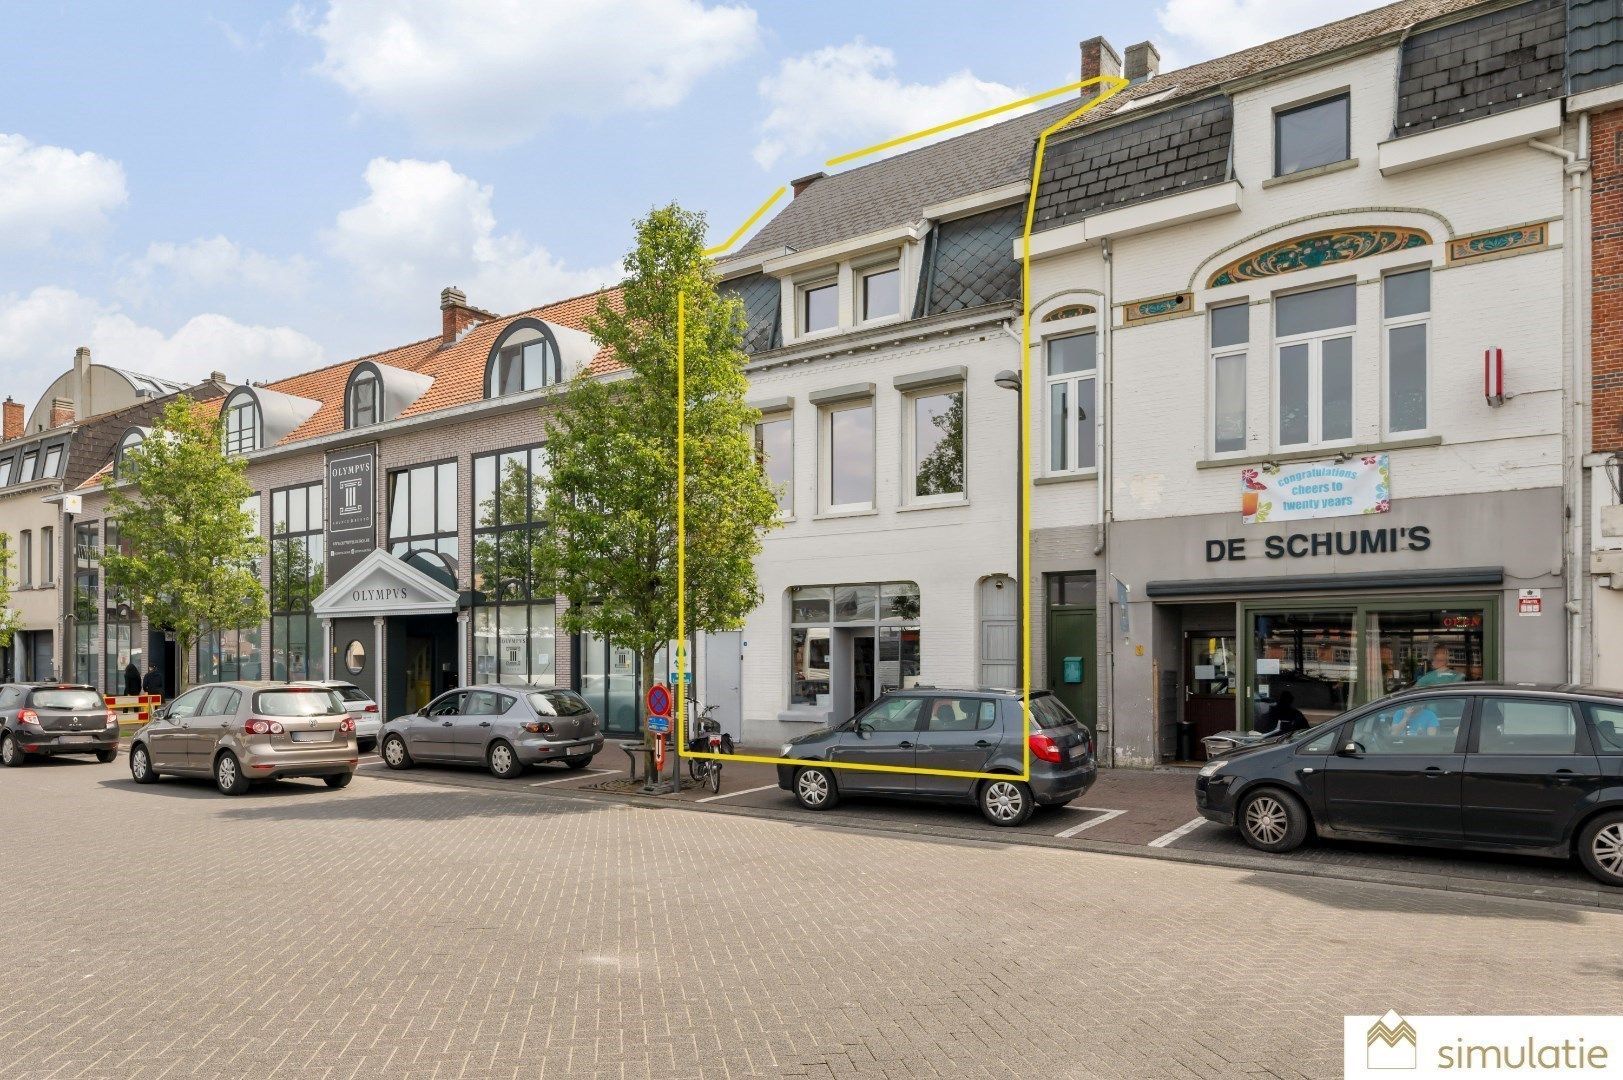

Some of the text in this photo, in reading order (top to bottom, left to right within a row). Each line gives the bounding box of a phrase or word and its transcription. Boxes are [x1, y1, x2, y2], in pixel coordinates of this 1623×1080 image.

[332, 462, 370, 477] OLYMPVS
[1277, 467, 1358, 487] congratulations
[1291, 481, 1343, 496] cheers to
[1283, 496, 1353, 511] twenty years
[1205, 525, 1431, 562] DE SCHUMI'S
[352, 587, 407, 602] OLYMPVS
